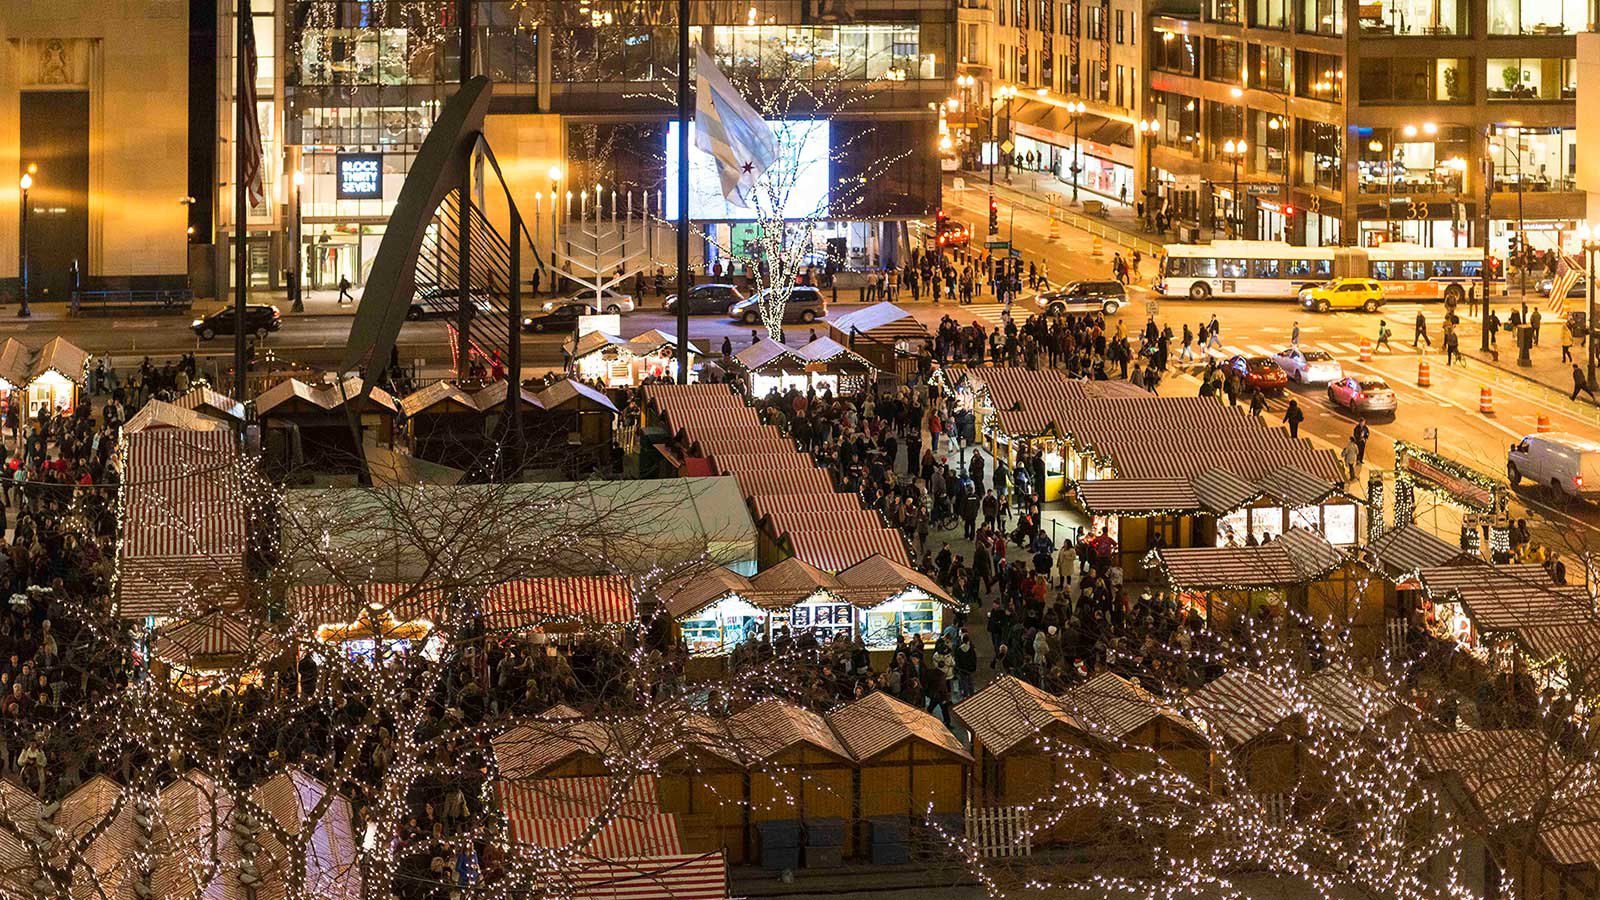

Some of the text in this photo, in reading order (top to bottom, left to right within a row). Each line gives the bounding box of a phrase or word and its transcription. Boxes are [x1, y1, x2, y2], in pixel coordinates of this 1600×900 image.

[342, 161, 378, 172] BLOCK
[342, 171, 378, 182] THIRTY
[342, 182, 377, 193] SEVEN
[1309, 193, 1320, 213] 33
[1406, 201, 1429, 220] 33
